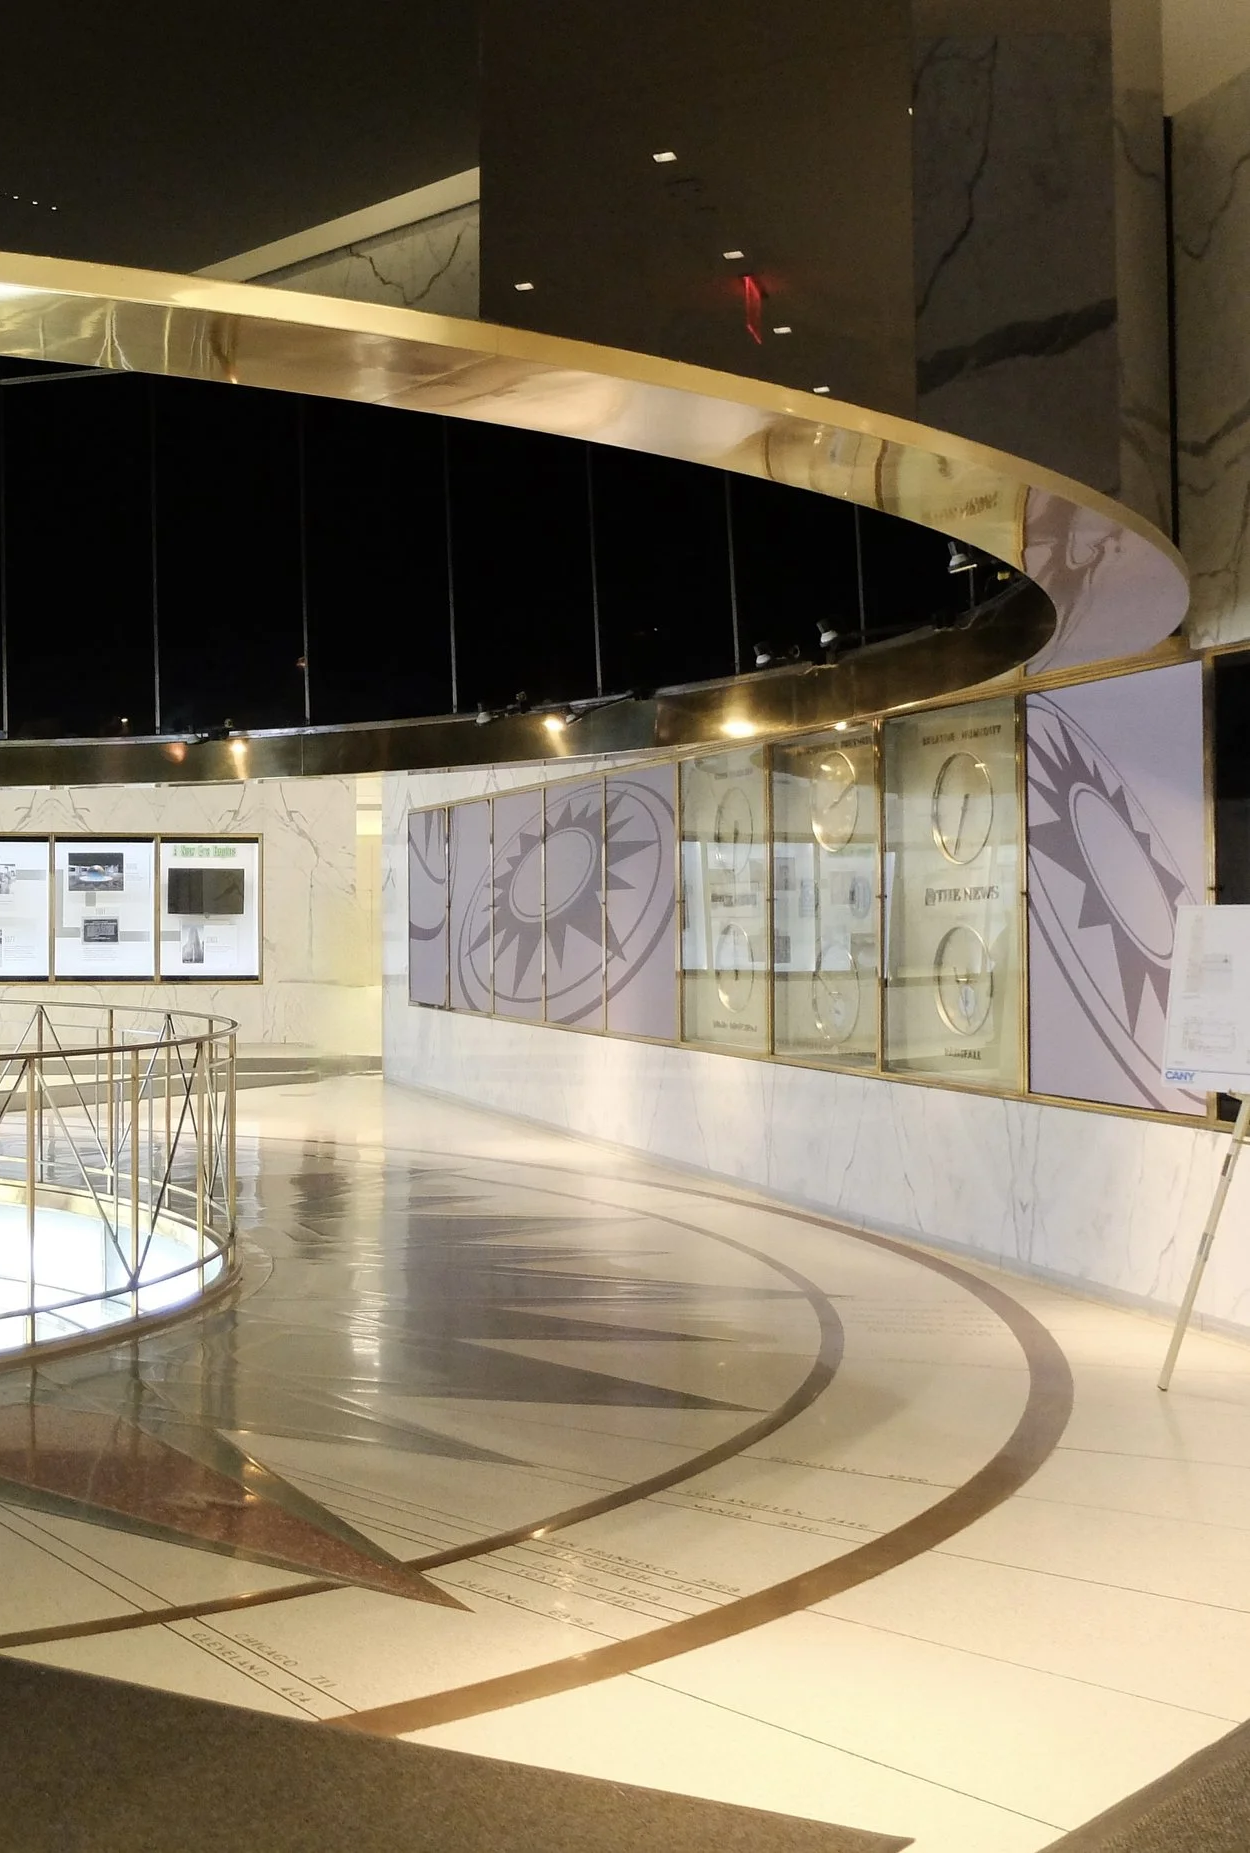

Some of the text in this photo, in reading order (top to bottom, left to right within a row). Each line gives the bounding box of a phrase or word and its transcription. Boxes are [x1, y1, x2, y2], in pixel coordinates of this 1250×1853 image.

[961, 724, 1002, 741] HUMIDITY
[935, 884, 1000, 903] THE NEWS
[1164, 1069, 1196, 1081] CANY
[542, 1549, 652, 1581] PITTSBURGH
[585, 1547, 679, 1576] FRANCISCO
[191, 1631, 312, 1704] CLEVELAND 404
[234, 1632, 338, 1689] CHICAGO 711
